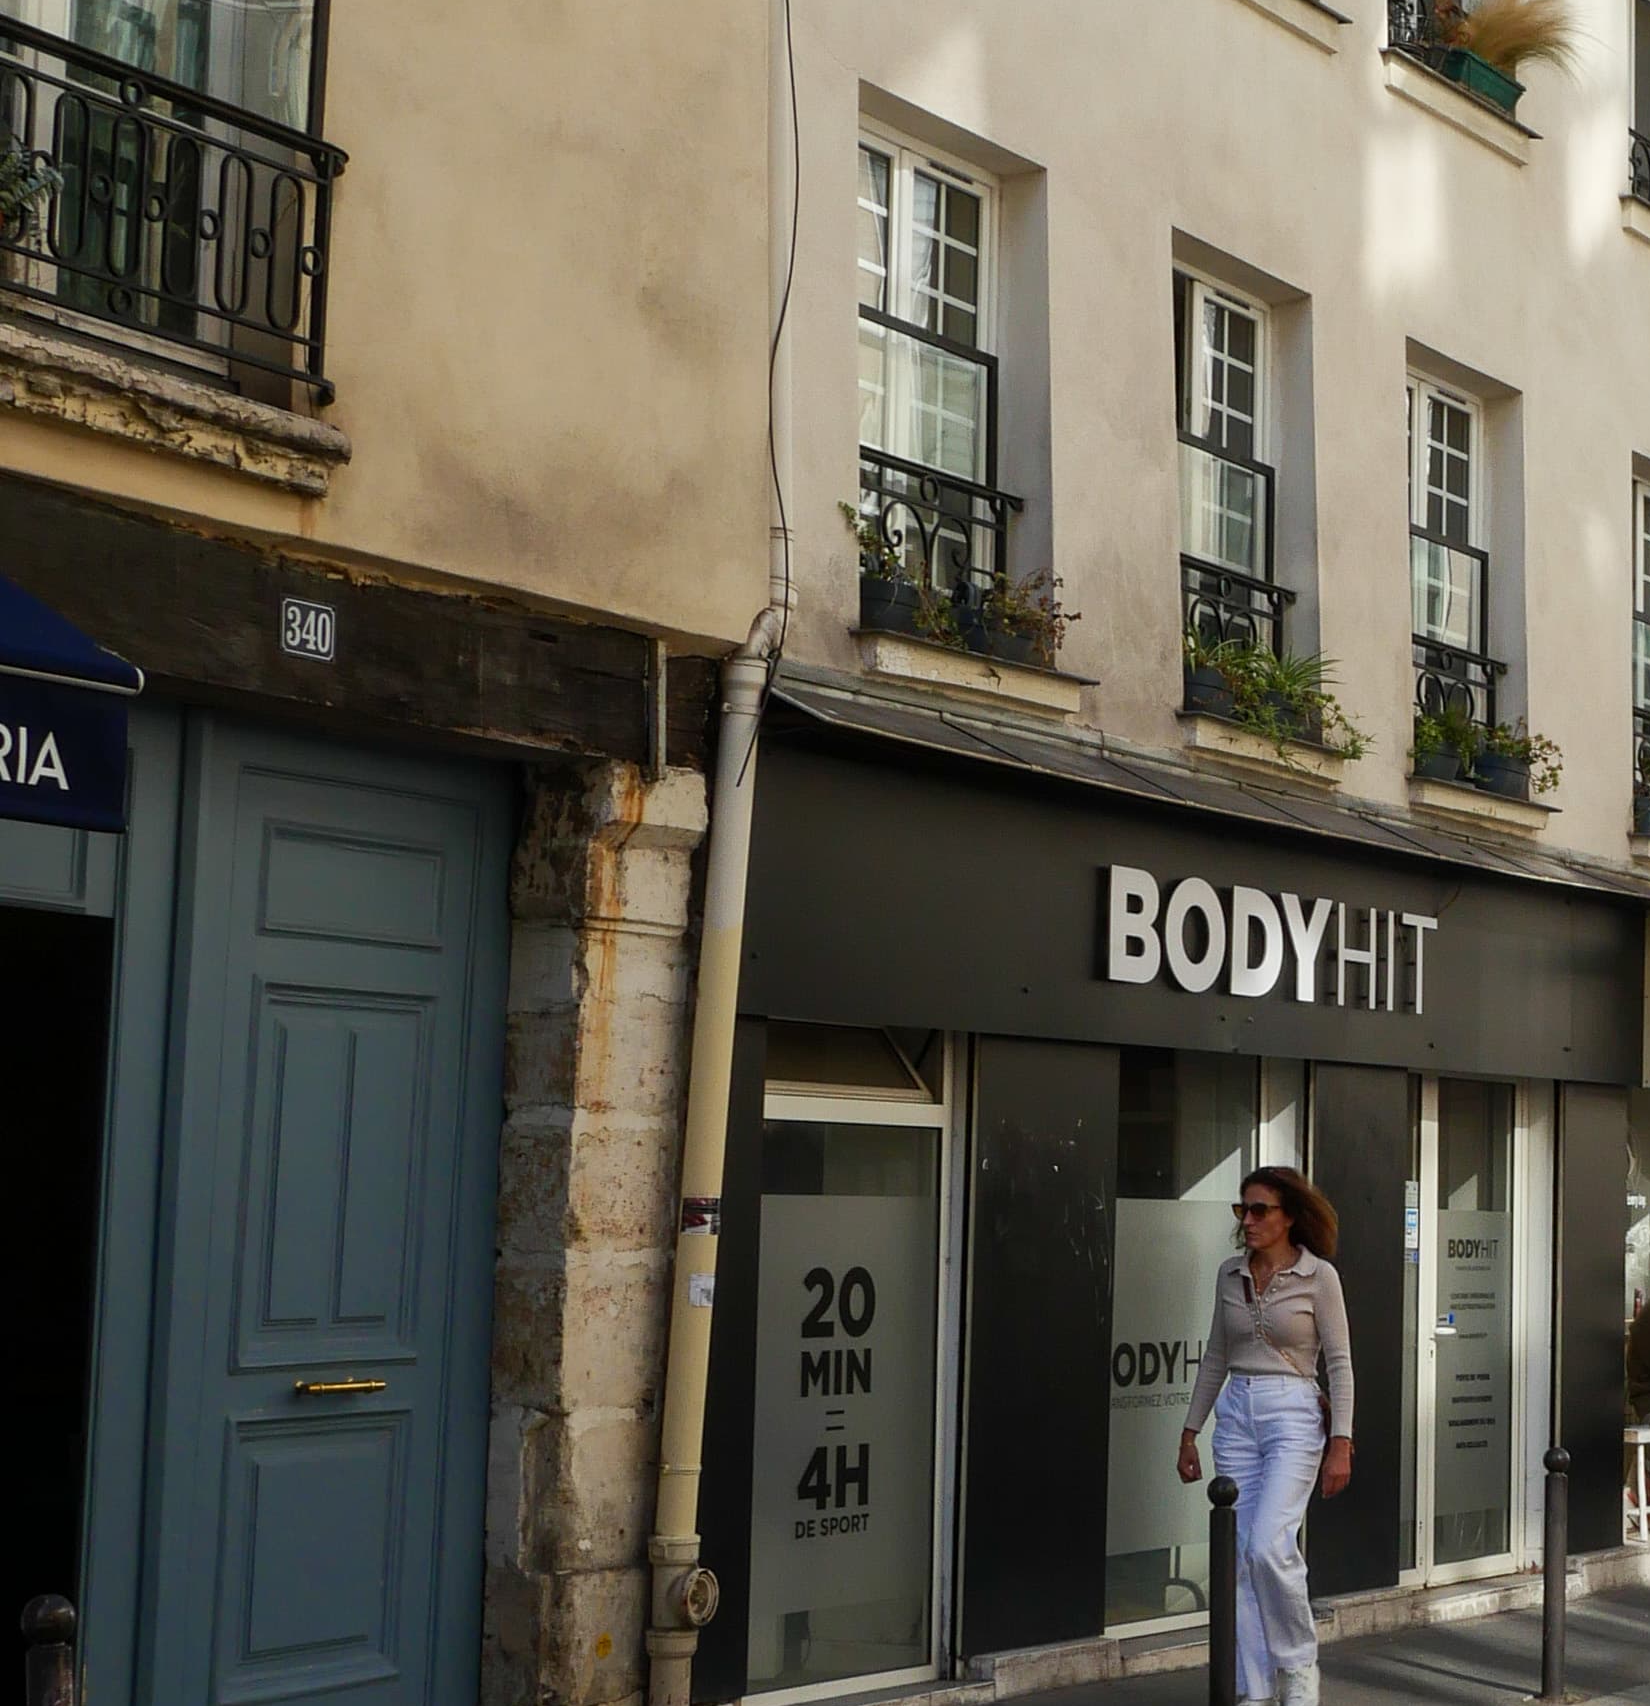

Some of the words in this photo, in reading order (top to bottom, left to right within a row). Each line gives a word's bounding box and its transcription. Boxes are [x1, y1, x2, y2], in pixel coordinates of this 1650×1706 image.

[286, 606, 331, 653] 340
[1108, 864, 1438, 1014] BODYHIT
[1447, 1239, 1499, 1259] BODYHIT
[801, 1266, 876, 1338] 20
[800, 1348, 871, 1397] MIN
[1112, 1340, 1202, 1387] ODYH
[797, 1443, 870, 1510] 4H
[795, 1520, 816, 1539] DE
[820, 1513, 870, 1537] SPORT
